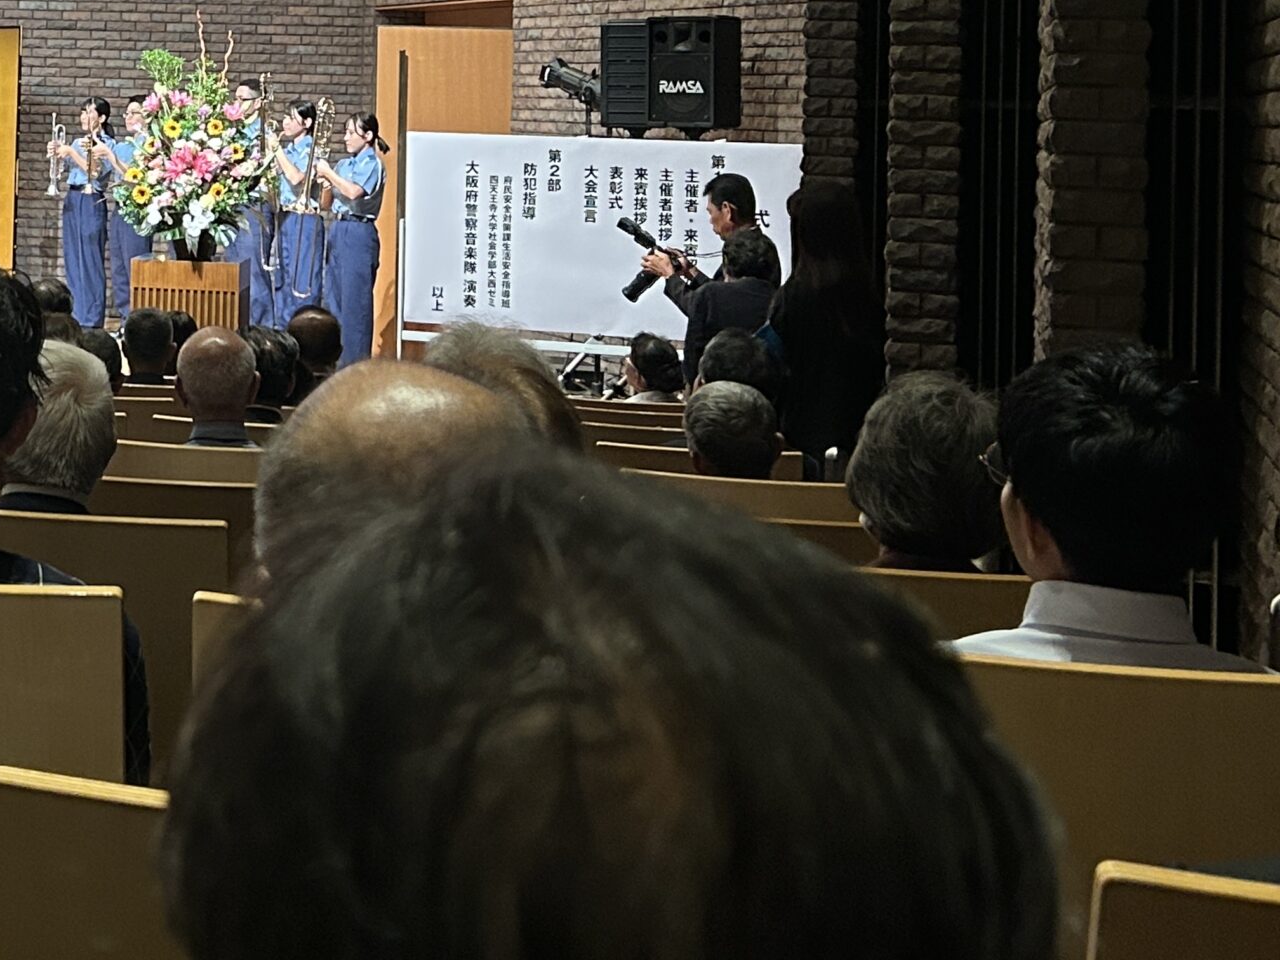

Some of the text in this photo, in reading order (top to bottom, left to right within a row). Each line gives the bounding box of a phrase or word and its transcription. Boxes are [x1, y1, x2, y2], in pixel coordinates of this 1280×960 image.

[658, 80, 704, 94] RAMSA
[521, 163, 537, 220] 防犯指導
[547, 149, 562, 192] 第2部
[583, 164, 599, 223] 大会宣言
[608, 165, 623, 209] 表彰式
[633, 167, 648, 225] 来賓挨拶
[658, 168, 674, 241] 主催者挨拶
[431, 286, 444, 311] 以上
